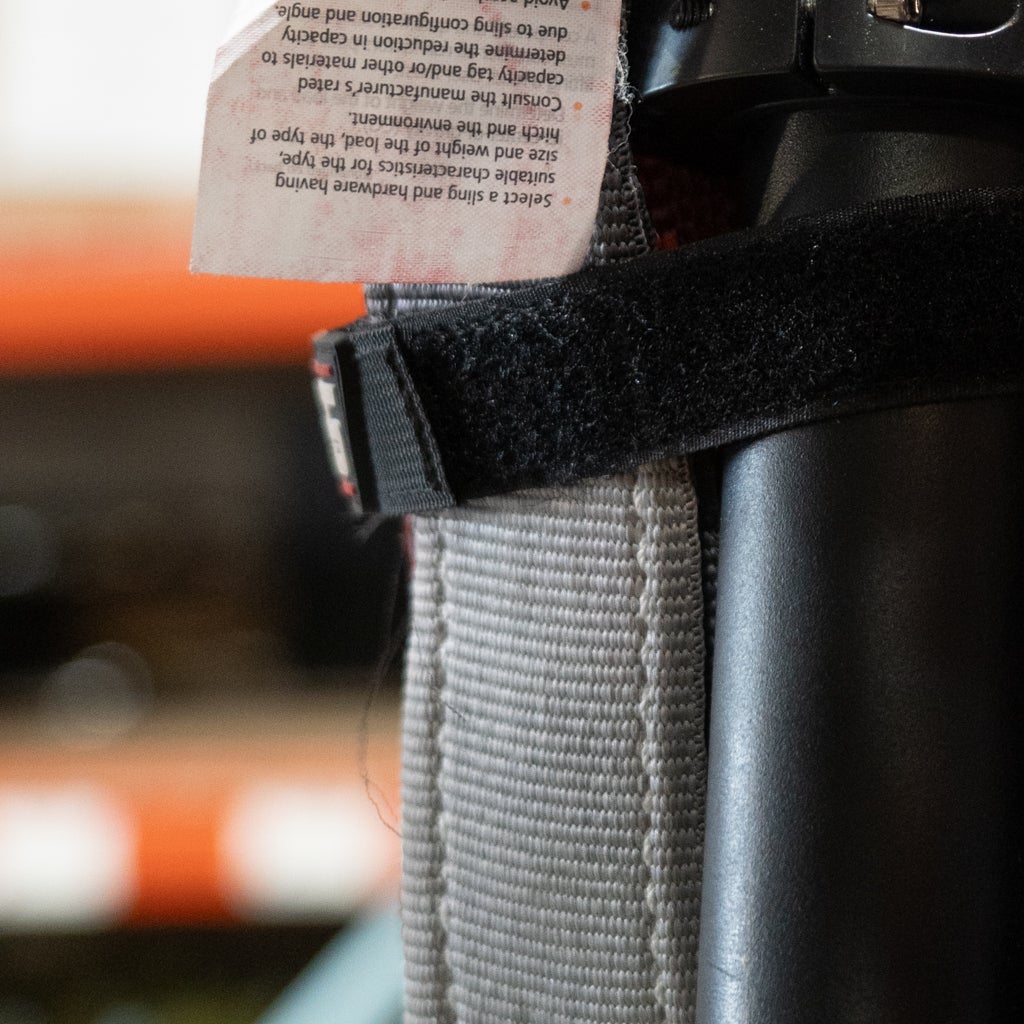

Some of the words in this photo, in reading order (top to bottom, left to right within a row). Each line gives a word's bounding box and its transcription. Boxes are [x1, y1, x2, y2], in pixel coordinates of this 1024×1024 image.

[275, 3, 321, 22] angle.
[325, 8, 357, 24] and
[361, 11, 470, 31] configuration
[473, 15, 512, 36] sling
[516, 23, 534, 38] to
[538, 25, 568, 40] due
[282, 26, 347, 44] capacity
[352, 34, 368, 47] in
[372, 35, 449, 55] reduction
[454, 42, 480, 58] the
[484, 44, 566, 64] determine
[261, 51, 278, 66] to
[282, 52, 357, 70] materials
[361, 58, 405, 75] other
[408, 62, 462, 79] and/or
[466, 62, 494, 82] tag
[498, 65, 565, 86] capacity
[297, 77, 340, 94] rated
[470, 90, 497, 107] the
[501, 92, 563, 112] Consult
[348, 112, 451, 131] environment.
[456, 120, 483, 138] the
[486, 122, 517, 139] and
[250, 128, 267, 145] of
[272, 129, 305, 146] type
[310, 132, 335, 150] the
[341, 133, 378, 153] load,
[522, 126, 560, 142] hitch
[384, 137, 410, 155] the
[413, 140, 431, 157] of
[434, 140, 490, 159] weight
[494, 146, 525, 162] and
[528, 148, 558, 162] size
[280, 151, 315, 169] type,
[321, 156, 346, 174] the
[350, 158, 373, 176] for
[378, 160, 491, 183] characteristics
[494, 168, 556, 185] suitable
[275, 172, 328, 195] having
[333, 179, 409, 201] hardware
[412, 185, 444, 202] and
[447, 185, 484, 205] sling
[488, 191, 499, 203] a
[503, 191, 553, 208] Select
